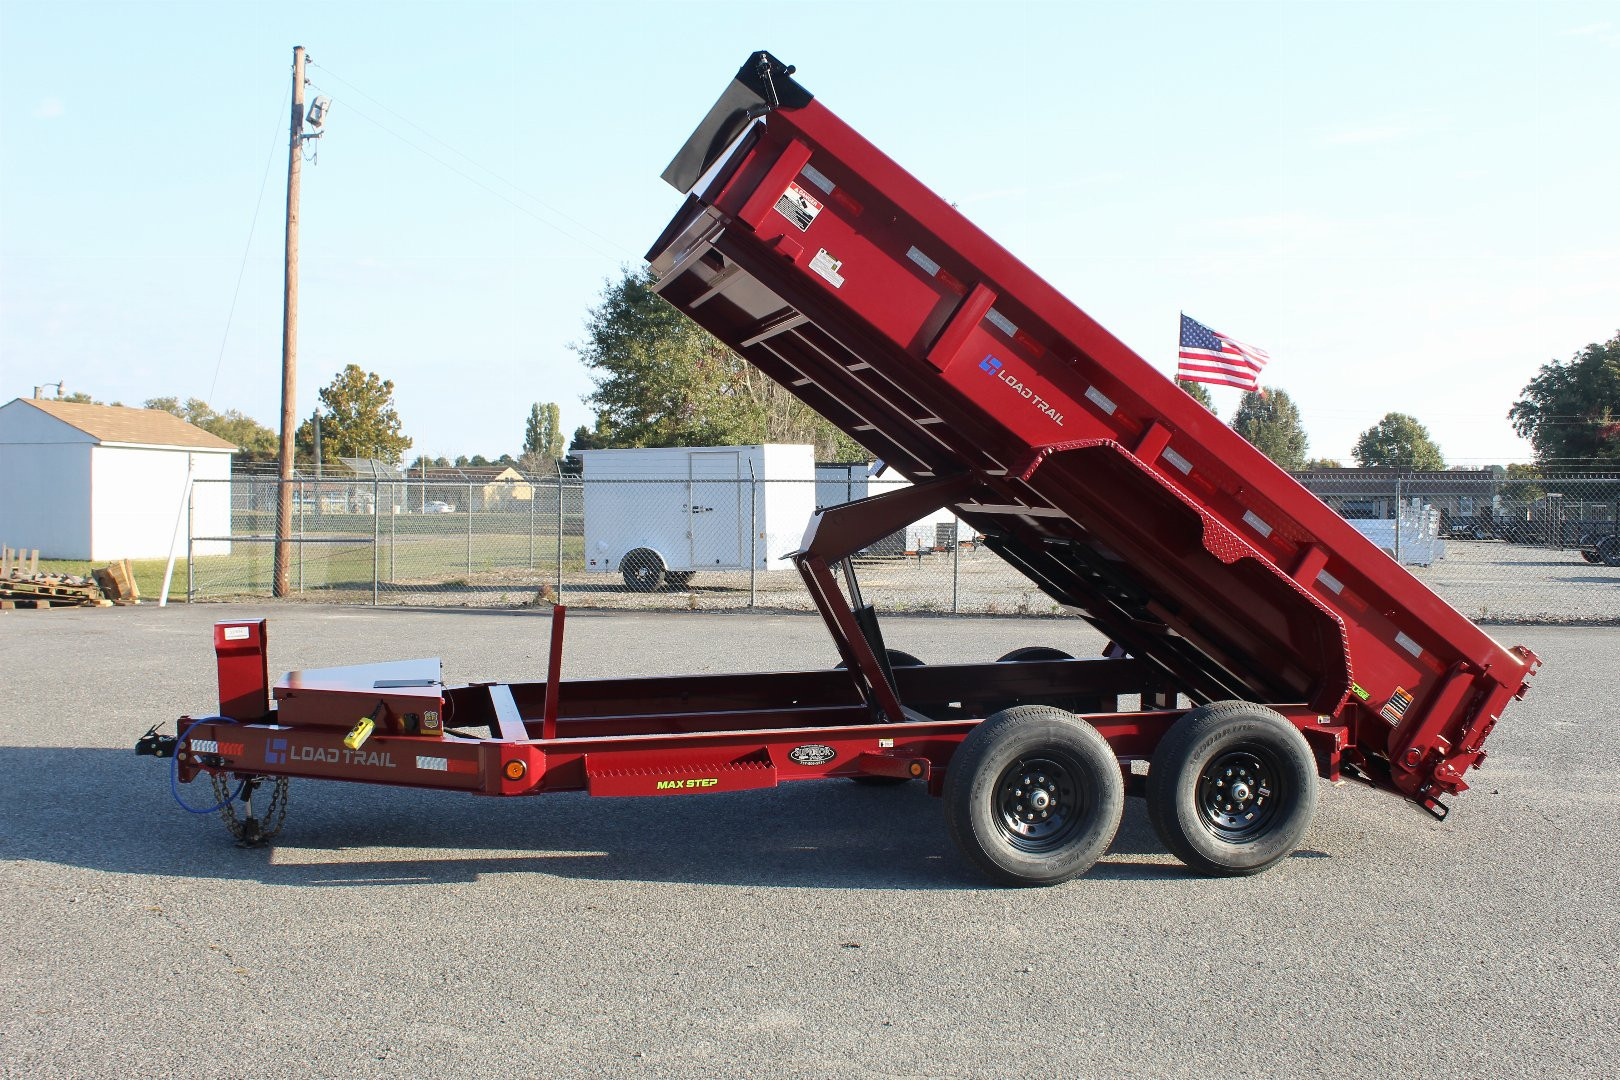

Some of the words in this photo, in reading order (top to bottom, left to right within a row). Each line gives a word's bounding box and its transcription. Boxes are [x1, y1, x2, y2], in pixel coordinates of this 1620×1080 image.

[997, 369, 1033, 399] LOAD
[1031, 395, 1064, 426] TRAIL
[290, 745, 339, 763] LOAD
[343, 749, 397, 768] TRAIL
[656, 780, 685, 790] MAX
[686, 778, 718, 788] STEP
